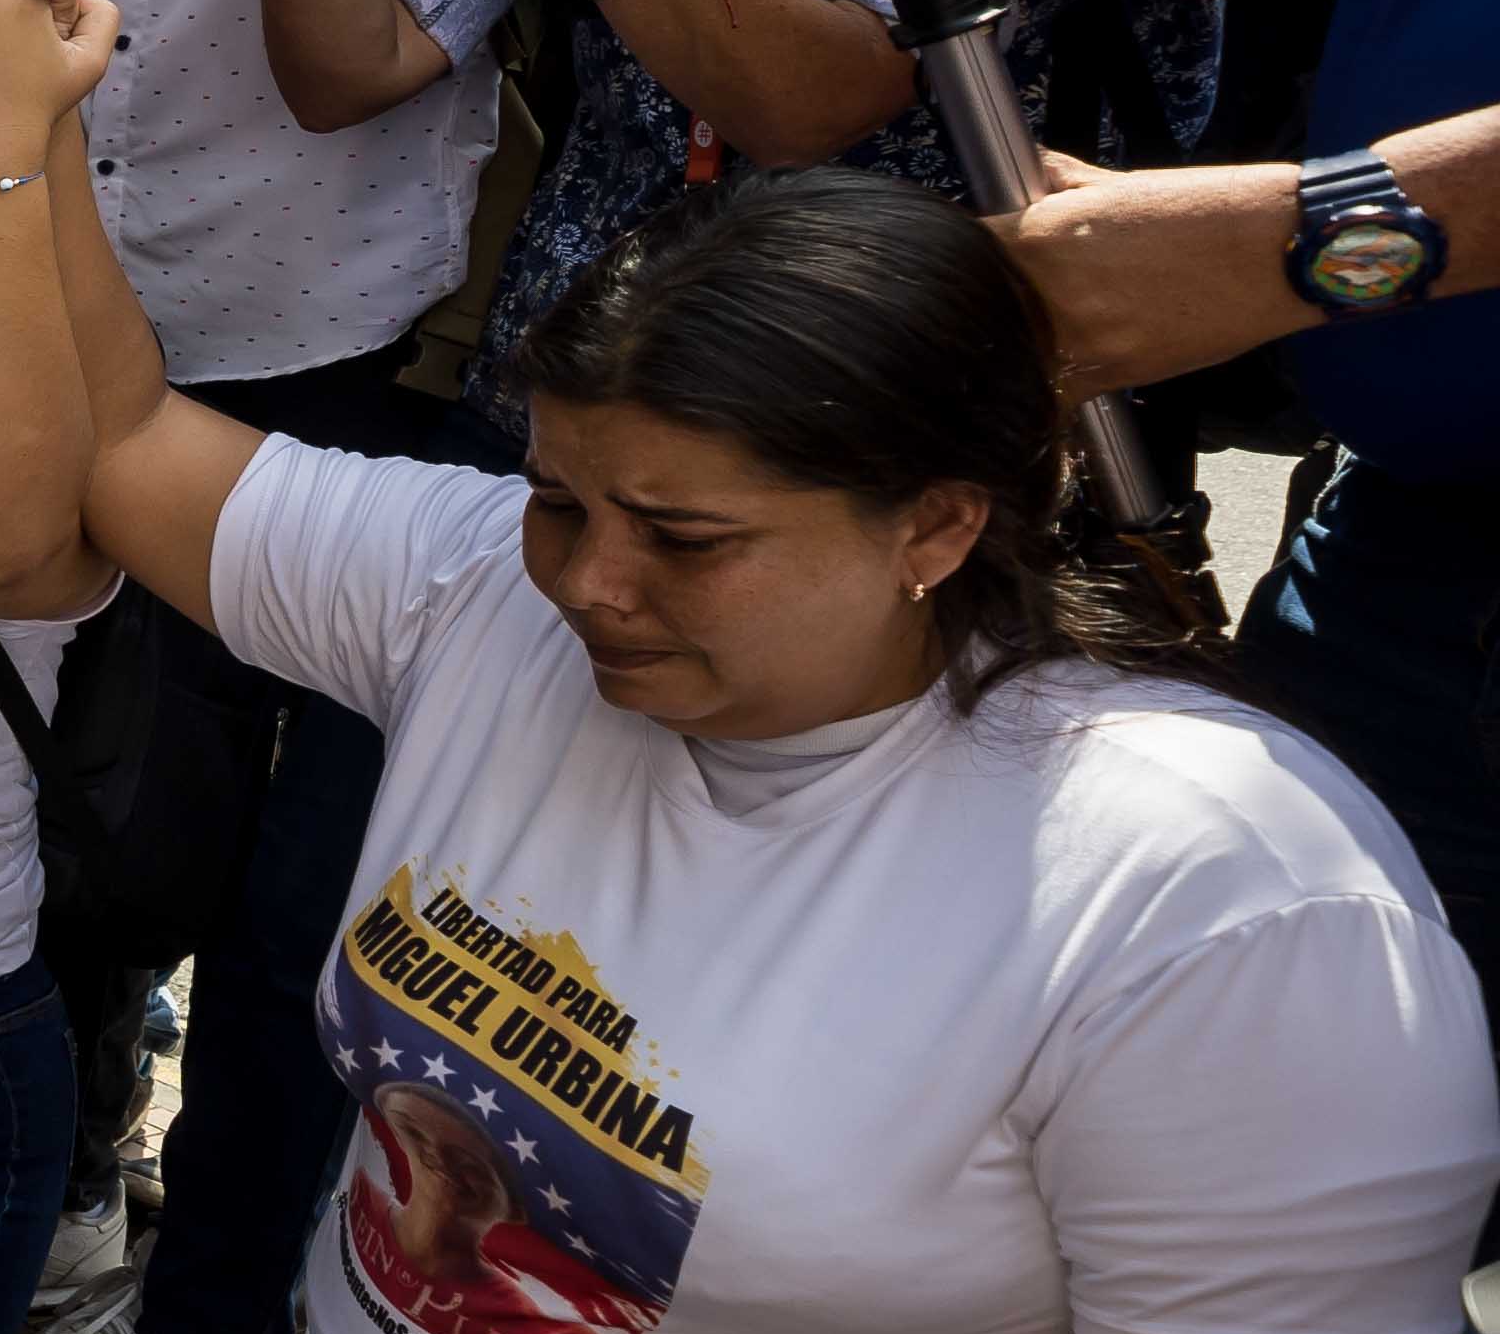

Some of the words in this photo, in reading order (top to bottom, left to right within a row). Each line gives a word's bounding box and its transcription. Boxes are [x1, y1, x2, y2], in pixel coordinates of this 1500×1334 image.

[354, 897, 500, 1037] MIGUEL
[490, 1005, 695, 1174] URBINA
[421, 888, 556, 995] LIBERTAD
[545, 975, 638, 1054] PARA
